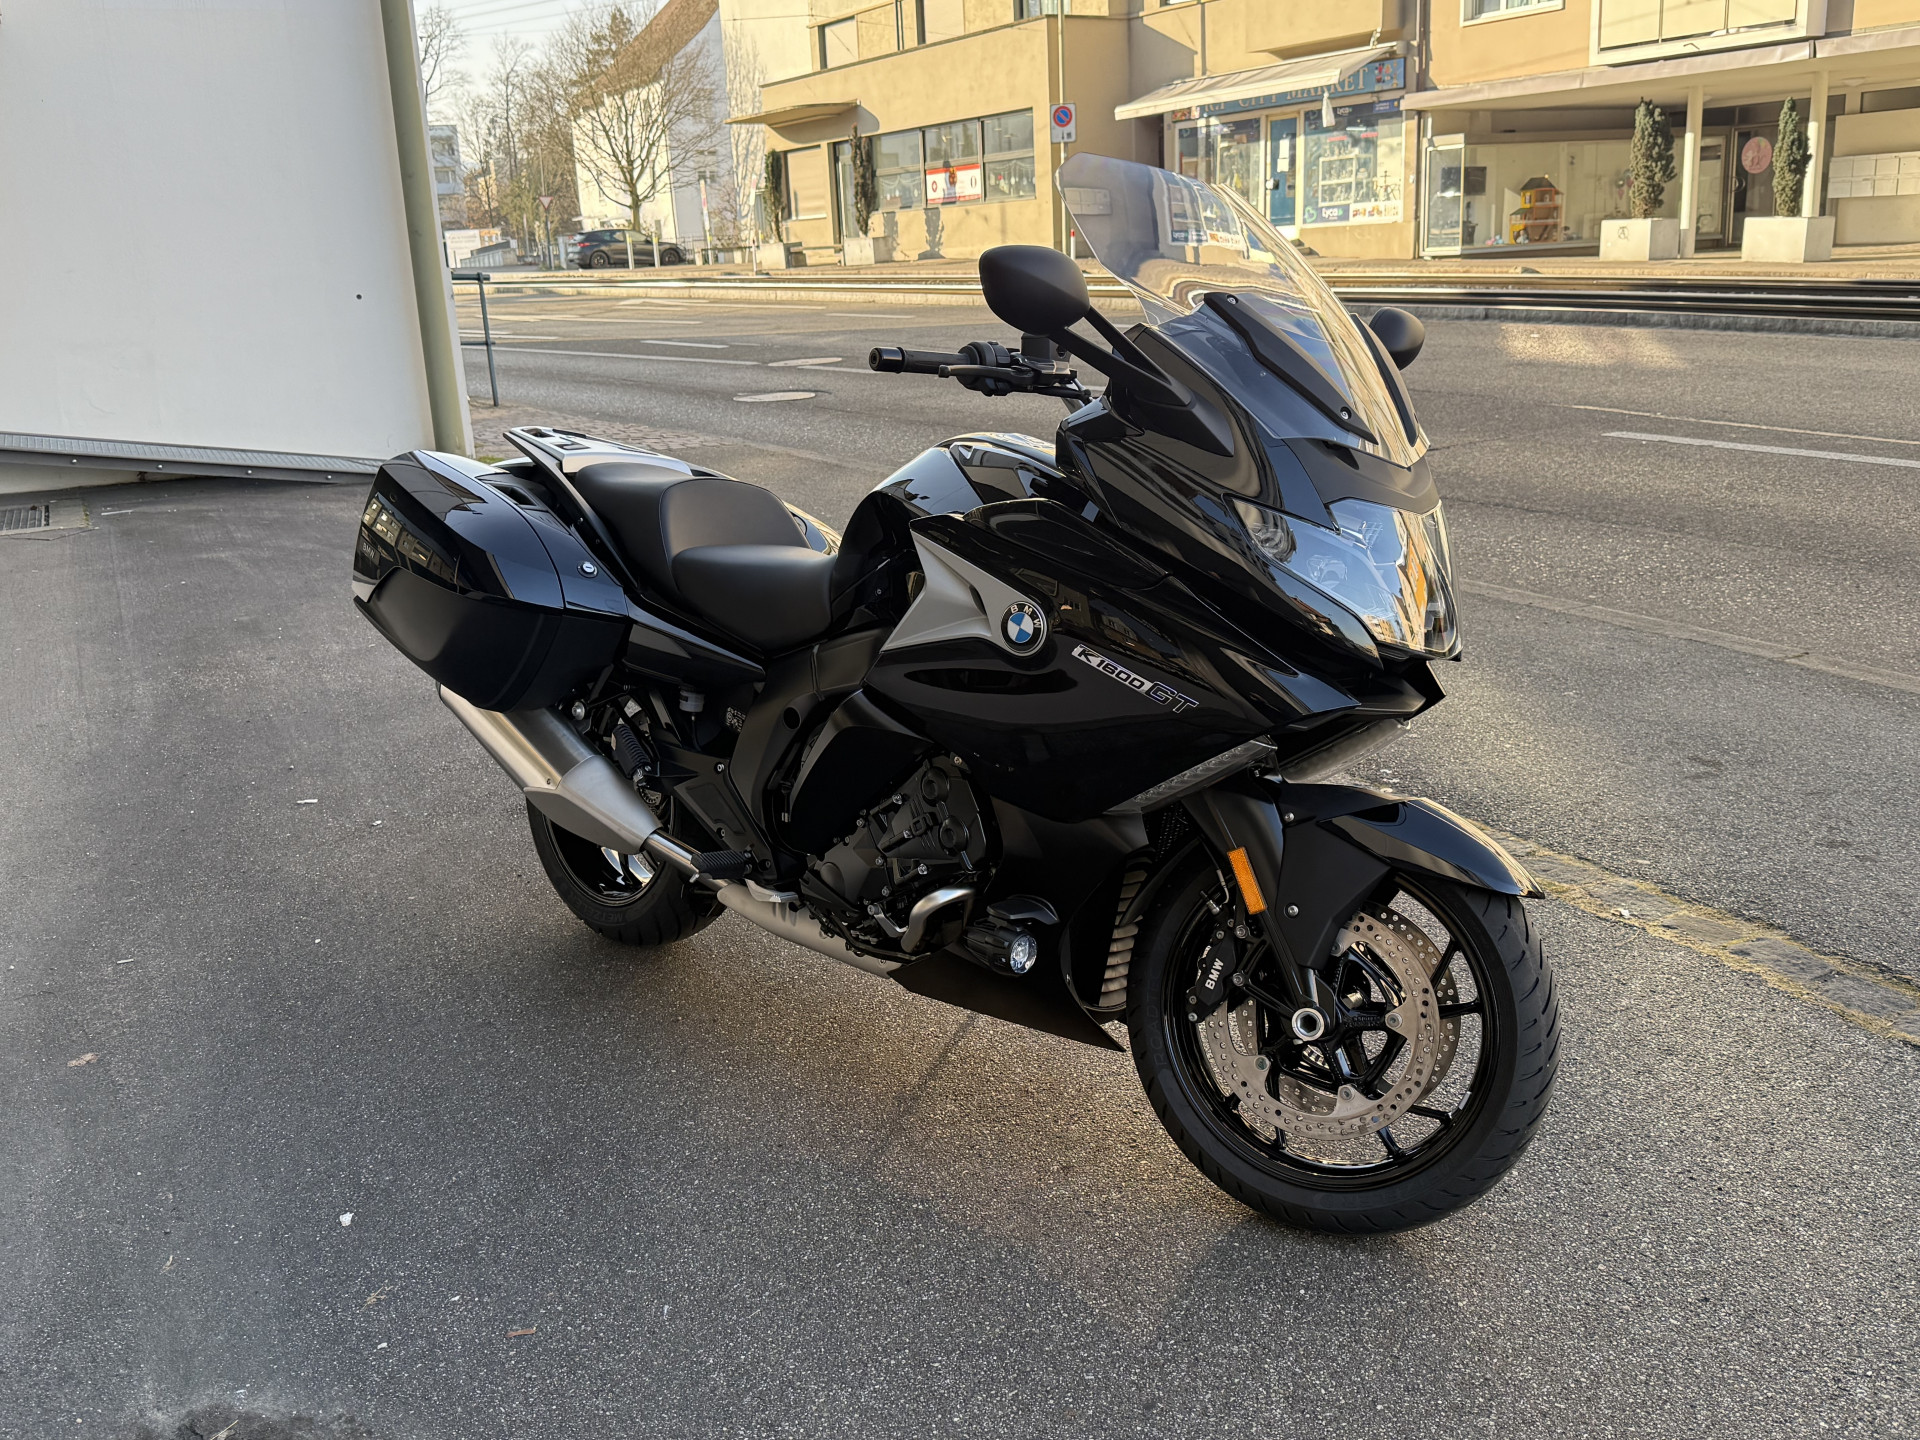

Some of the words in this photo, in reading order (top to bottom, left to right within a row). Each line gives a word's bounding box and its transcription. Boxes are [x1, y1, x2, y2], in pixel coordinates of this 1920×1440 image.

[362, 542, 376, 558] BMW
[1010, 604, 1042, 629] BMW
[1145, 681, 1199, 714] GT
[1204, 957, 1224, 990] BMW
